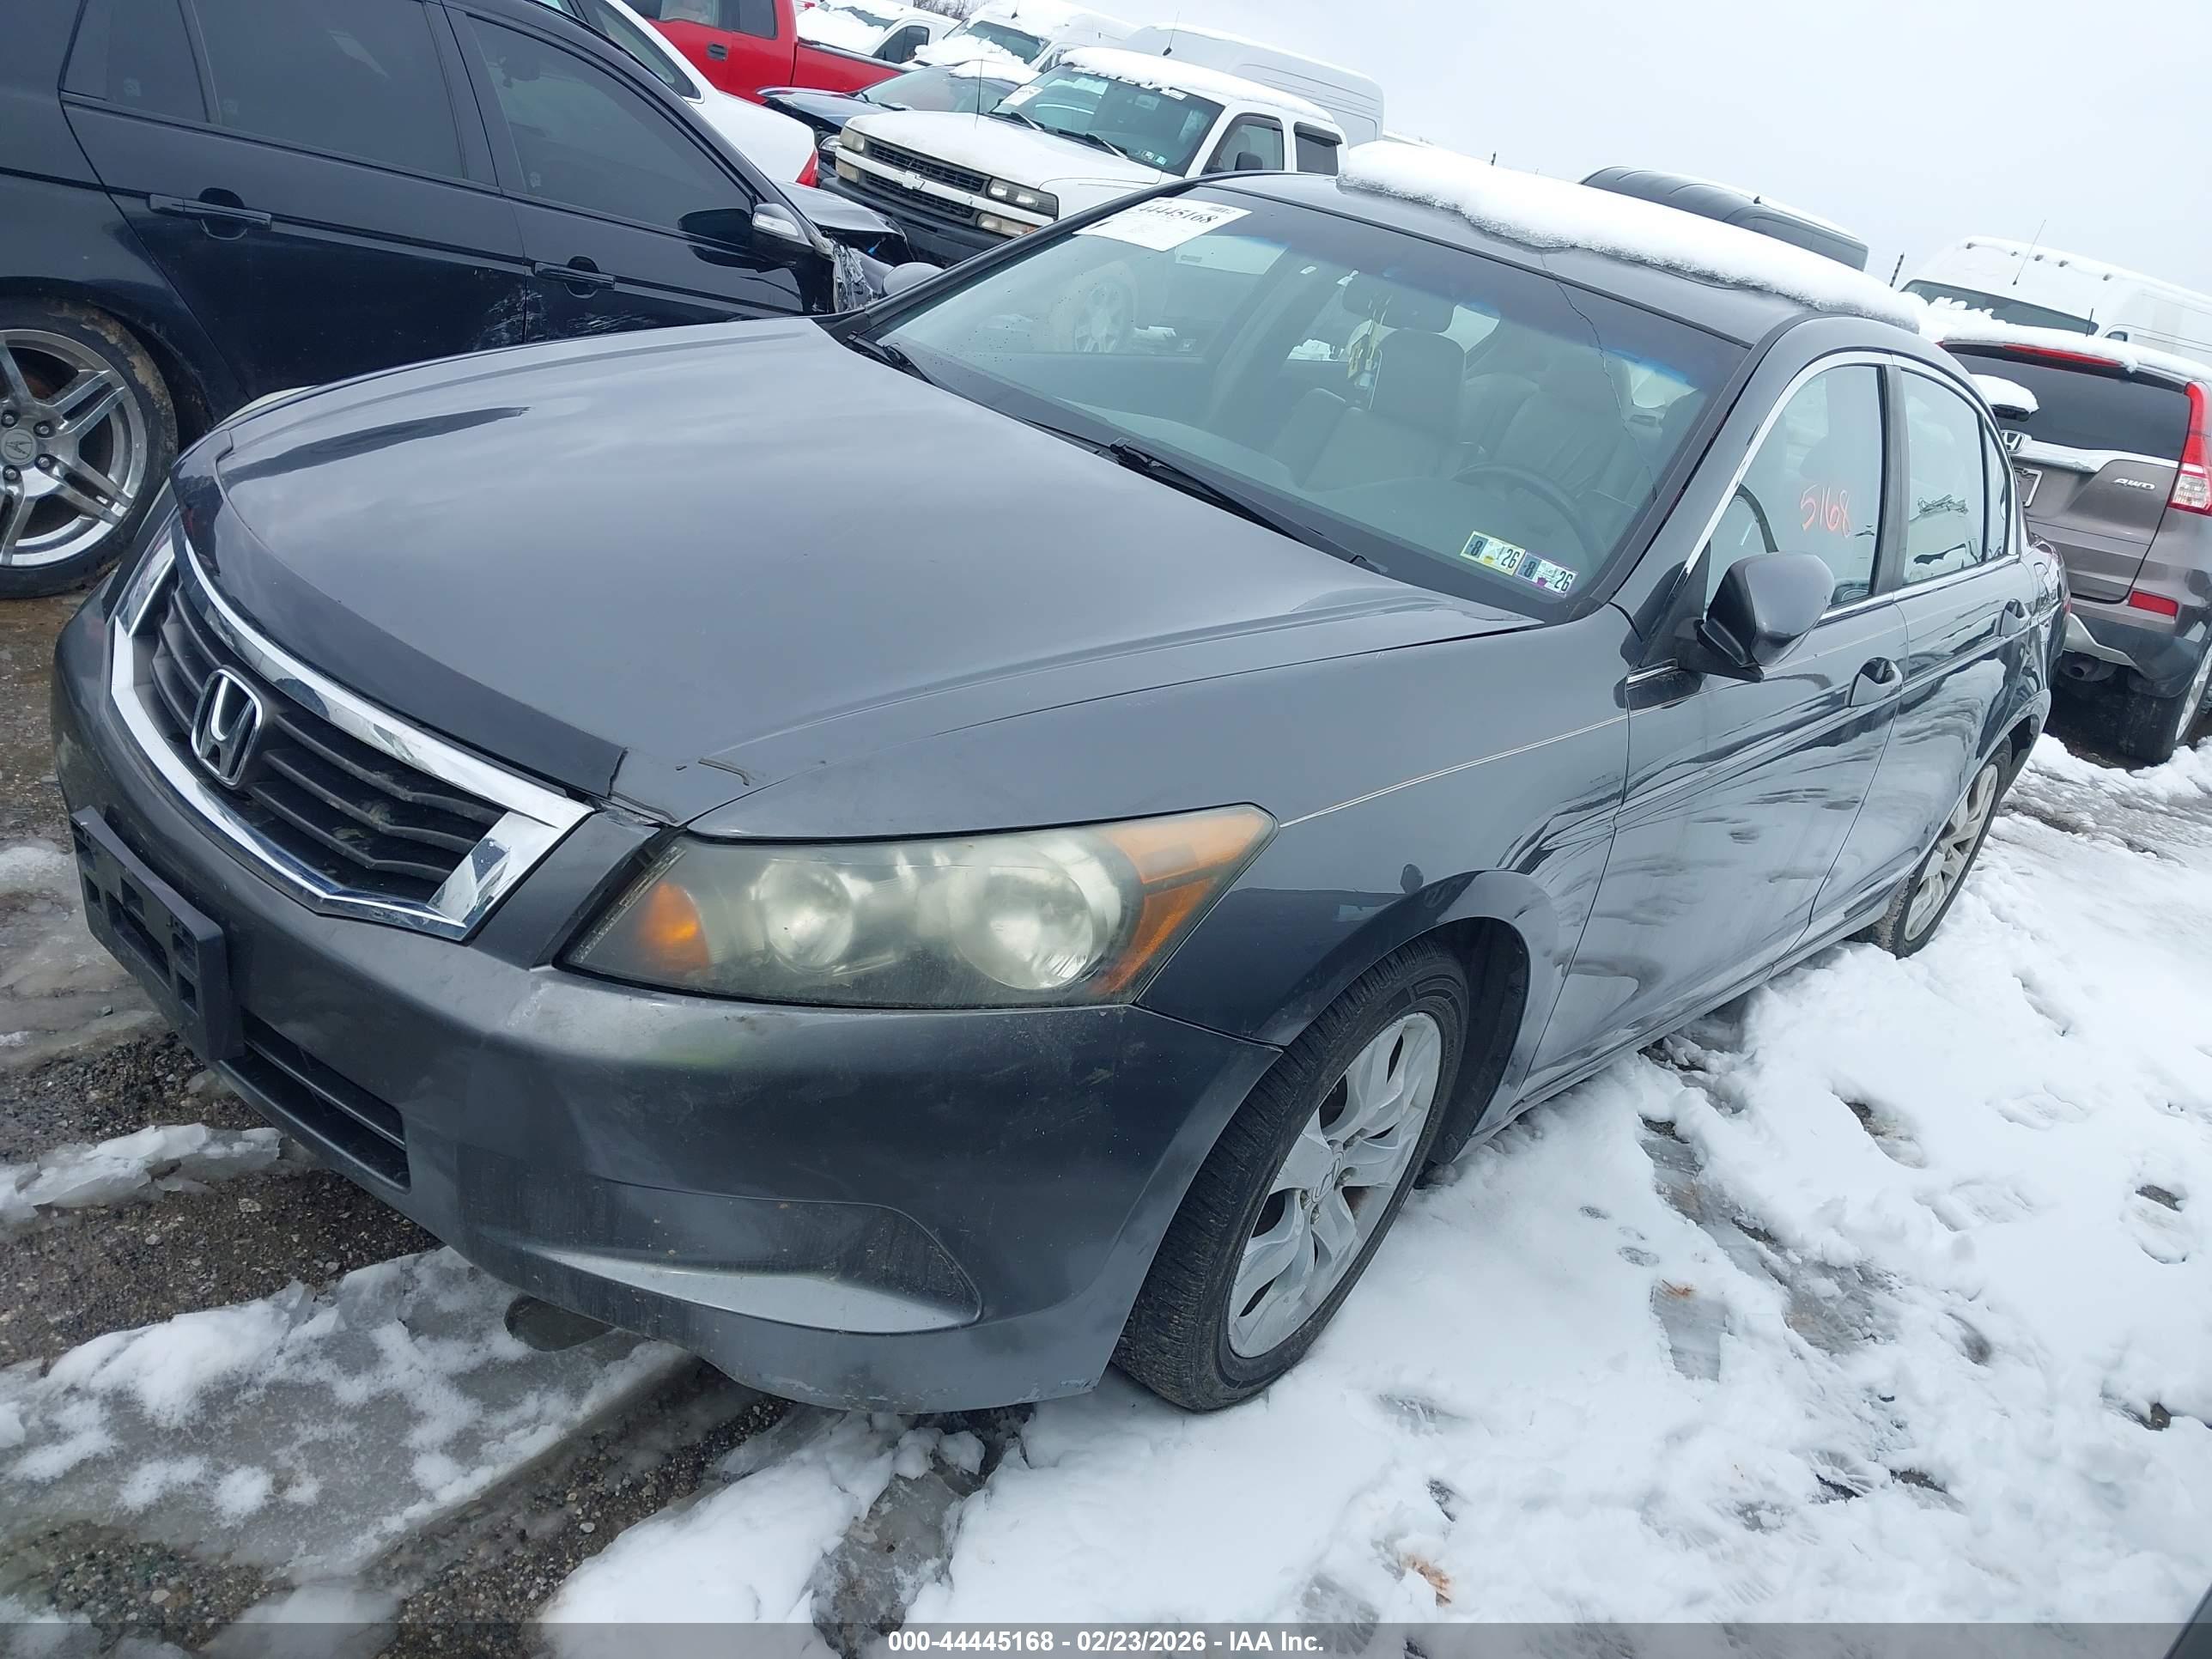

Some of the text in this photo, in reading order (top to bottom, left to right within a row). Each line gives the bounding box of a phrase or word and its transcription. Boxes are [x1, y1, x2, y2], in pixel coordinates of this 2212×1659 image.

[2113, 477, 2156, 491] AWD
[1800, 483, 1850, 538] 5168
[1501, 548, 1520, 568] 26
[1553, 570, 1573, 592] 26
